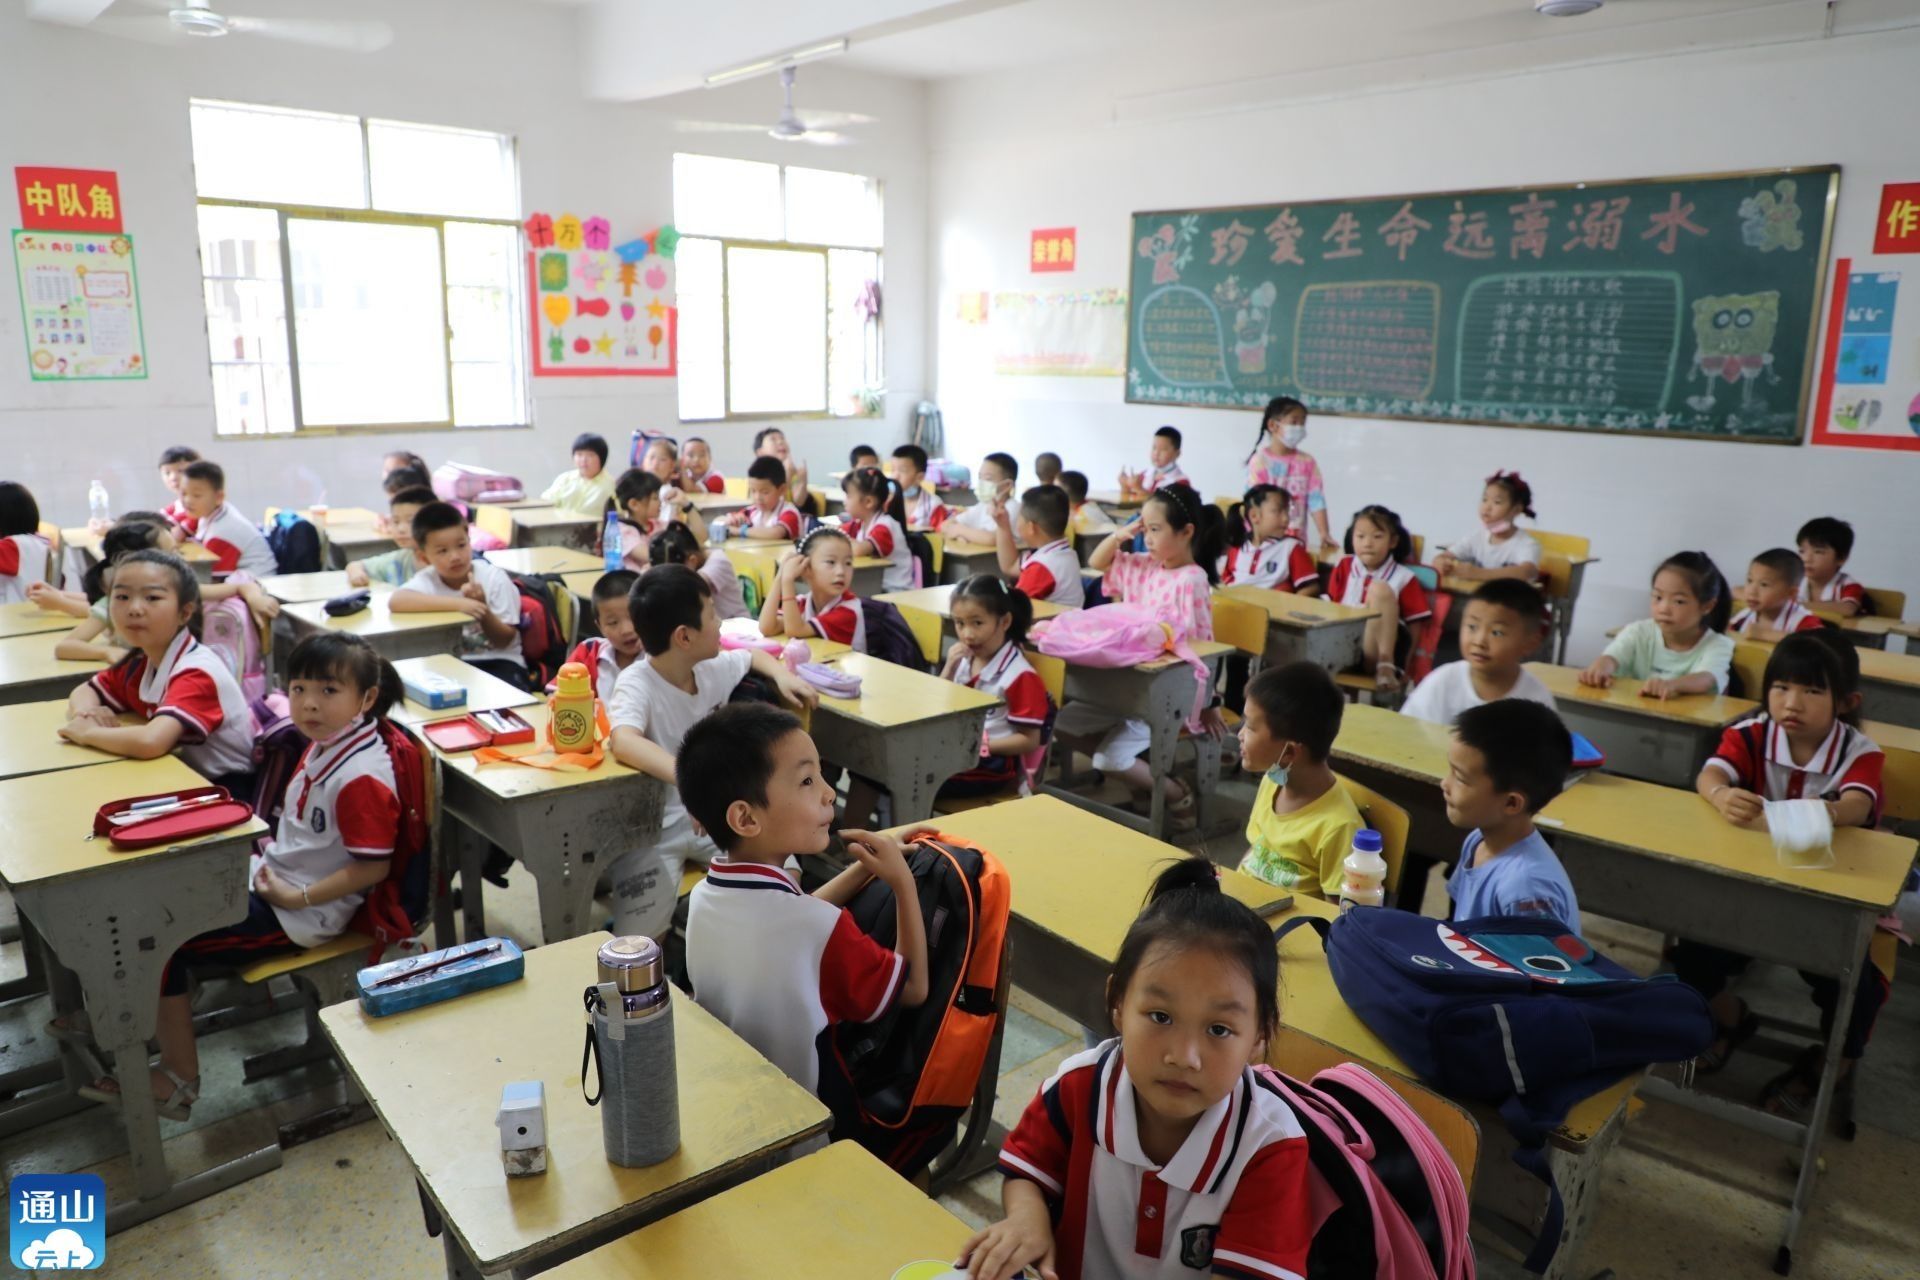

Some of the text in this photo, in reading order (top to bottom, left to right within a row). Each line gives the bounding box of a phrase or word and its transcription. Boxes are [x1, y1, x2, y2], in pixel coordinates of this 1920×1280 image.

[25, 179, 115, 220] 中队角
[533, 221, 607, 244] 十万个
[1209, 190, 1710, 267] 珍爱生命远离溺水
